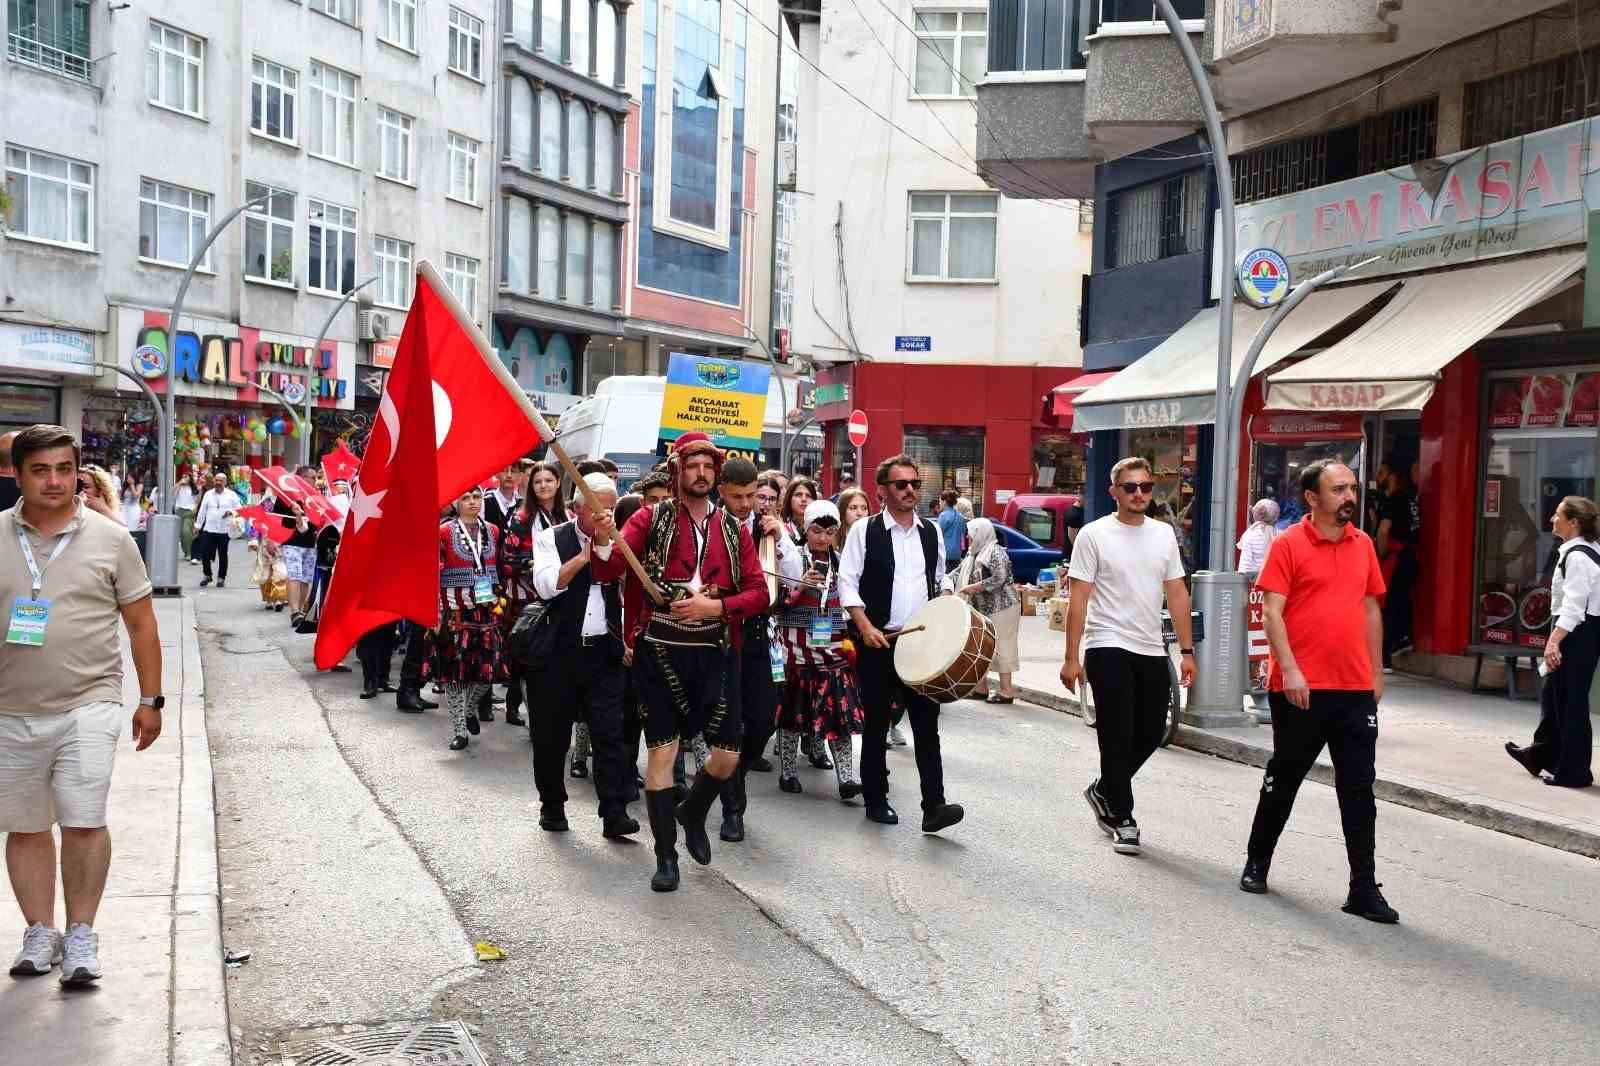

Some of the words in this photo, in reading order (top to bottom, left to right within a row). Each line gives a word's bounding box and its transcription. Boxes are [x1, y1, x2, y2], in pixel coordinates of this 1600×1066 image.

[690, 396, 740, 409] AKÇAABAT
[1309, 384, 1386, 408] KASAP
[688, 405, 739, 418] BELEDİYESİ
[1123, 402, 1181, 425] KASAP
[676, 412, 701, 422] HALK
[703, 415, 748, 428] OYUNLARI
